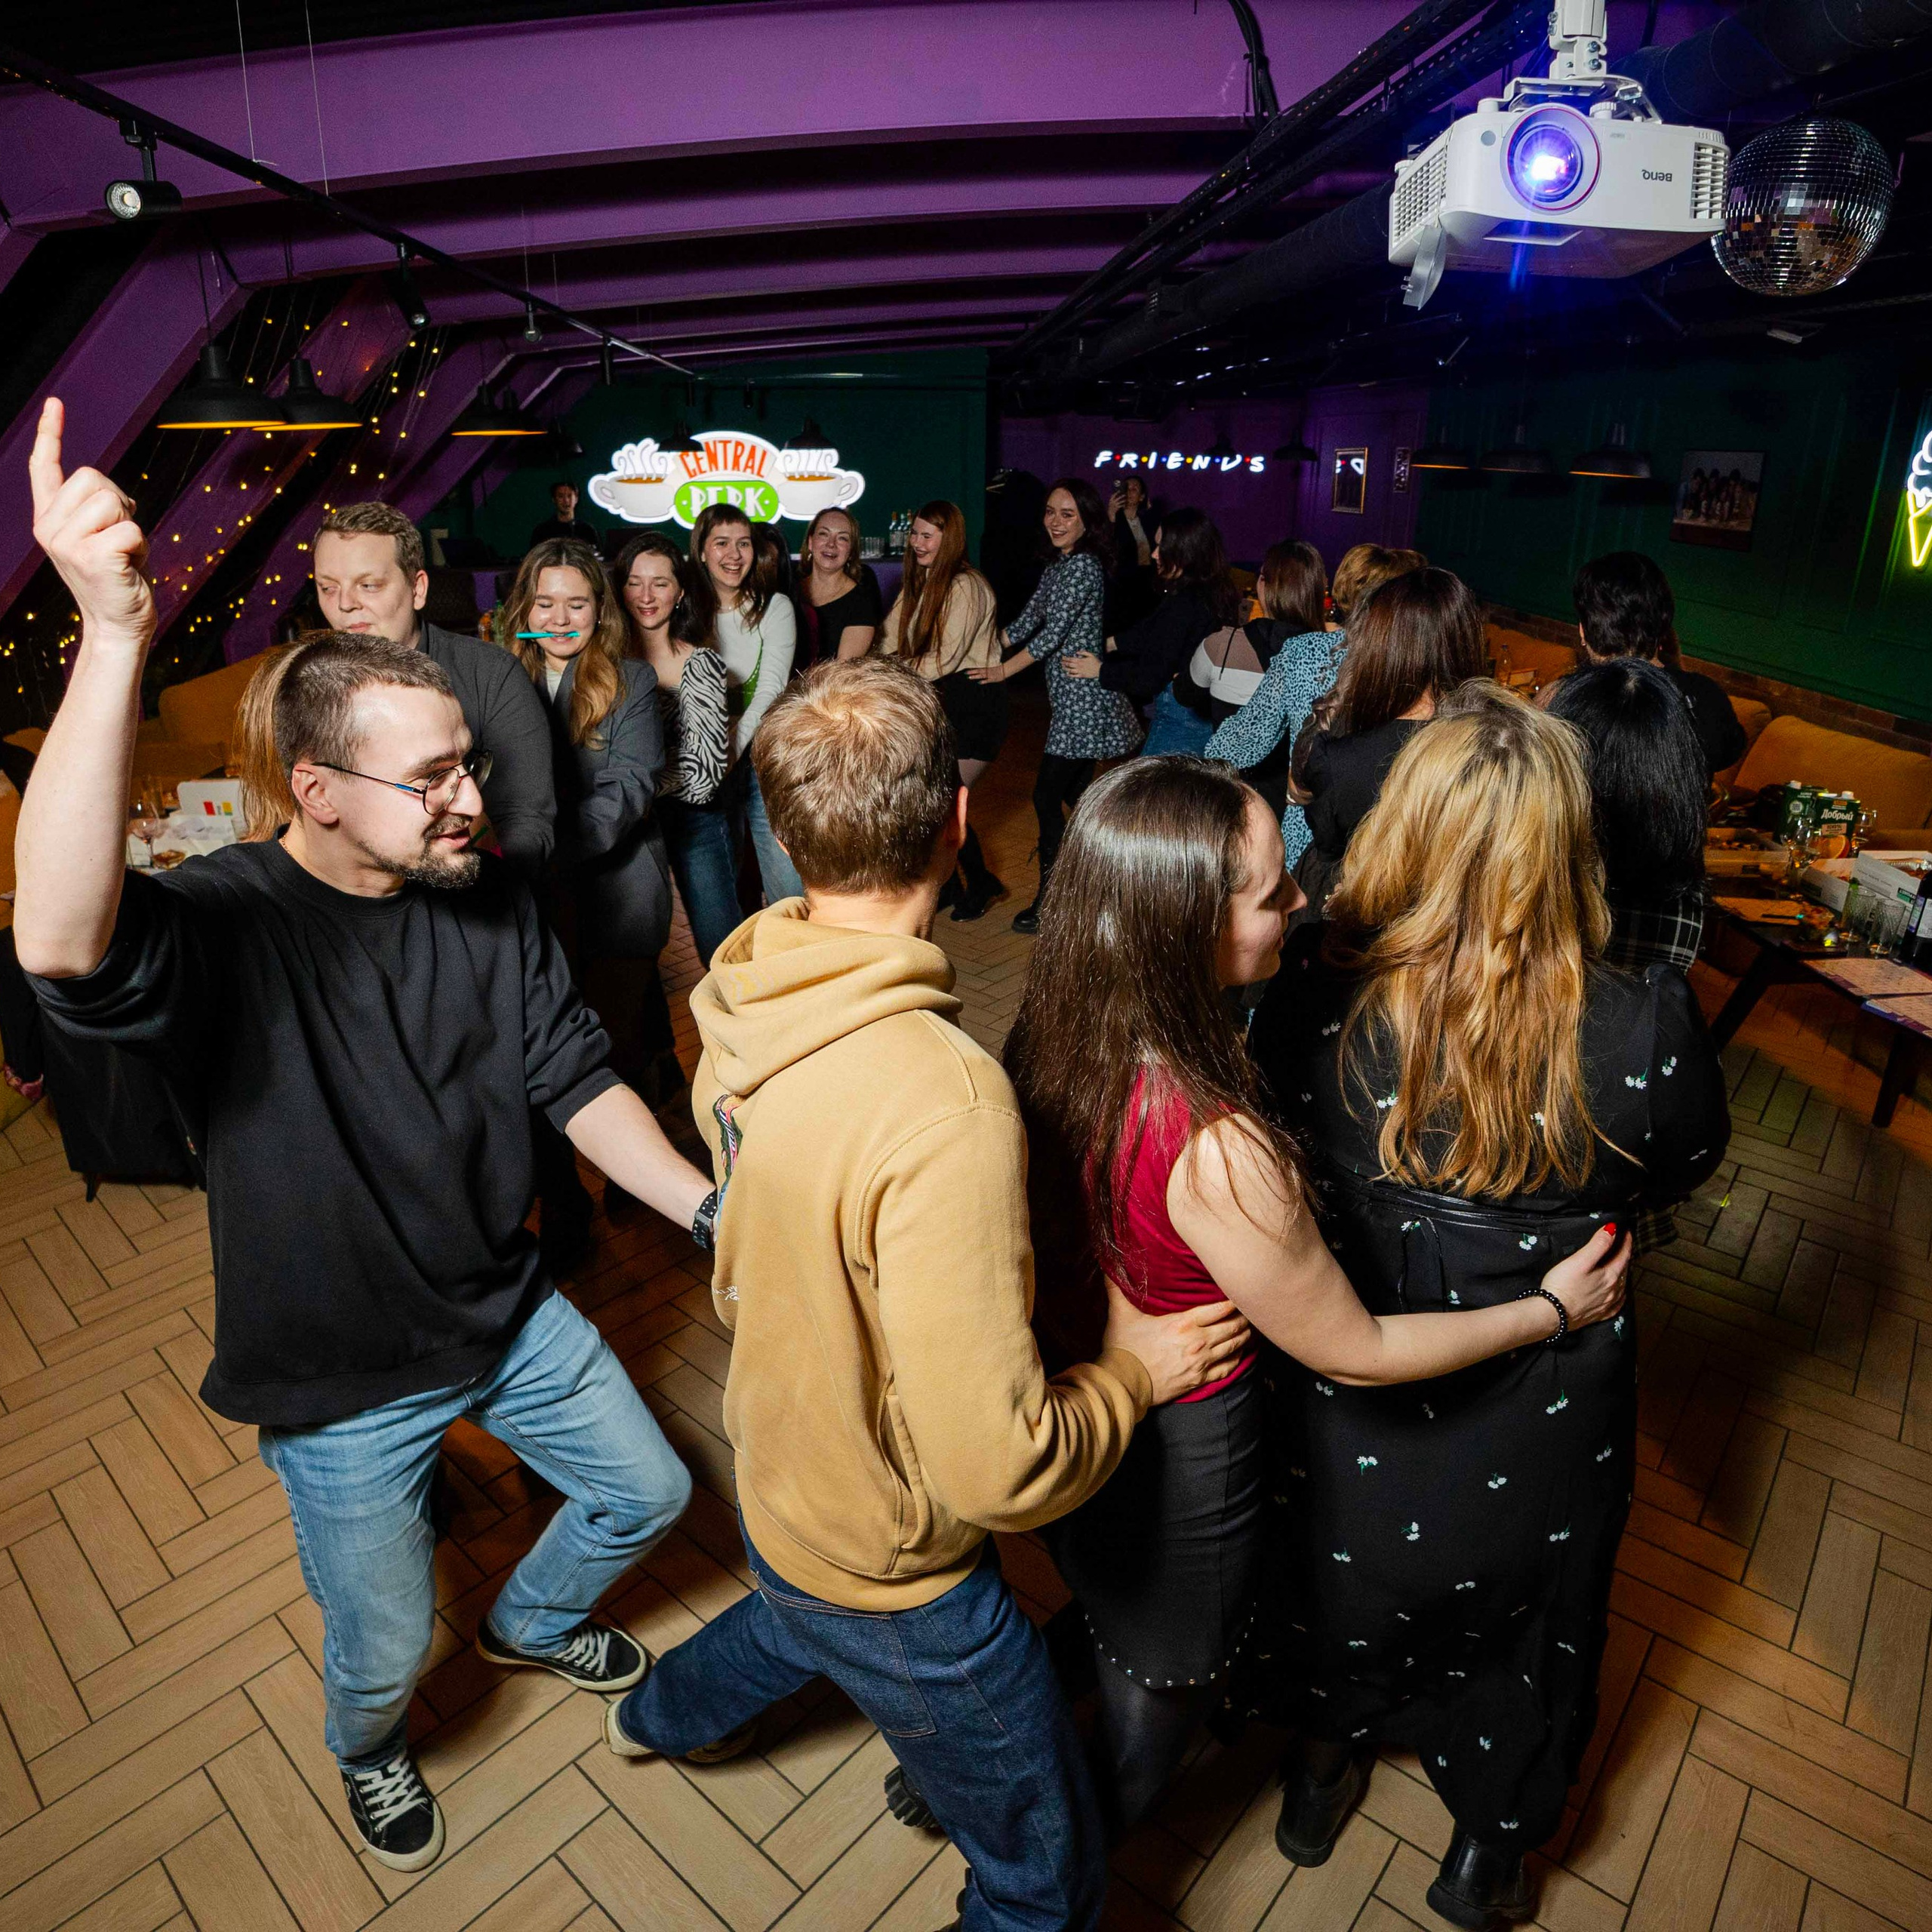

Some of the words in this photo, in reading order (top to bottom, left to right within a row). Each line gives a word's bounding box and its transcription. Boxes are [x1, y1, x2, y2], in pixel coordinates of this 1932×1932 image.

[1641, 169, 1672, 182] BenQ
[679, 440, 768, 479] CENTRAL
[1820, 809, 1854, 821] Добрый
